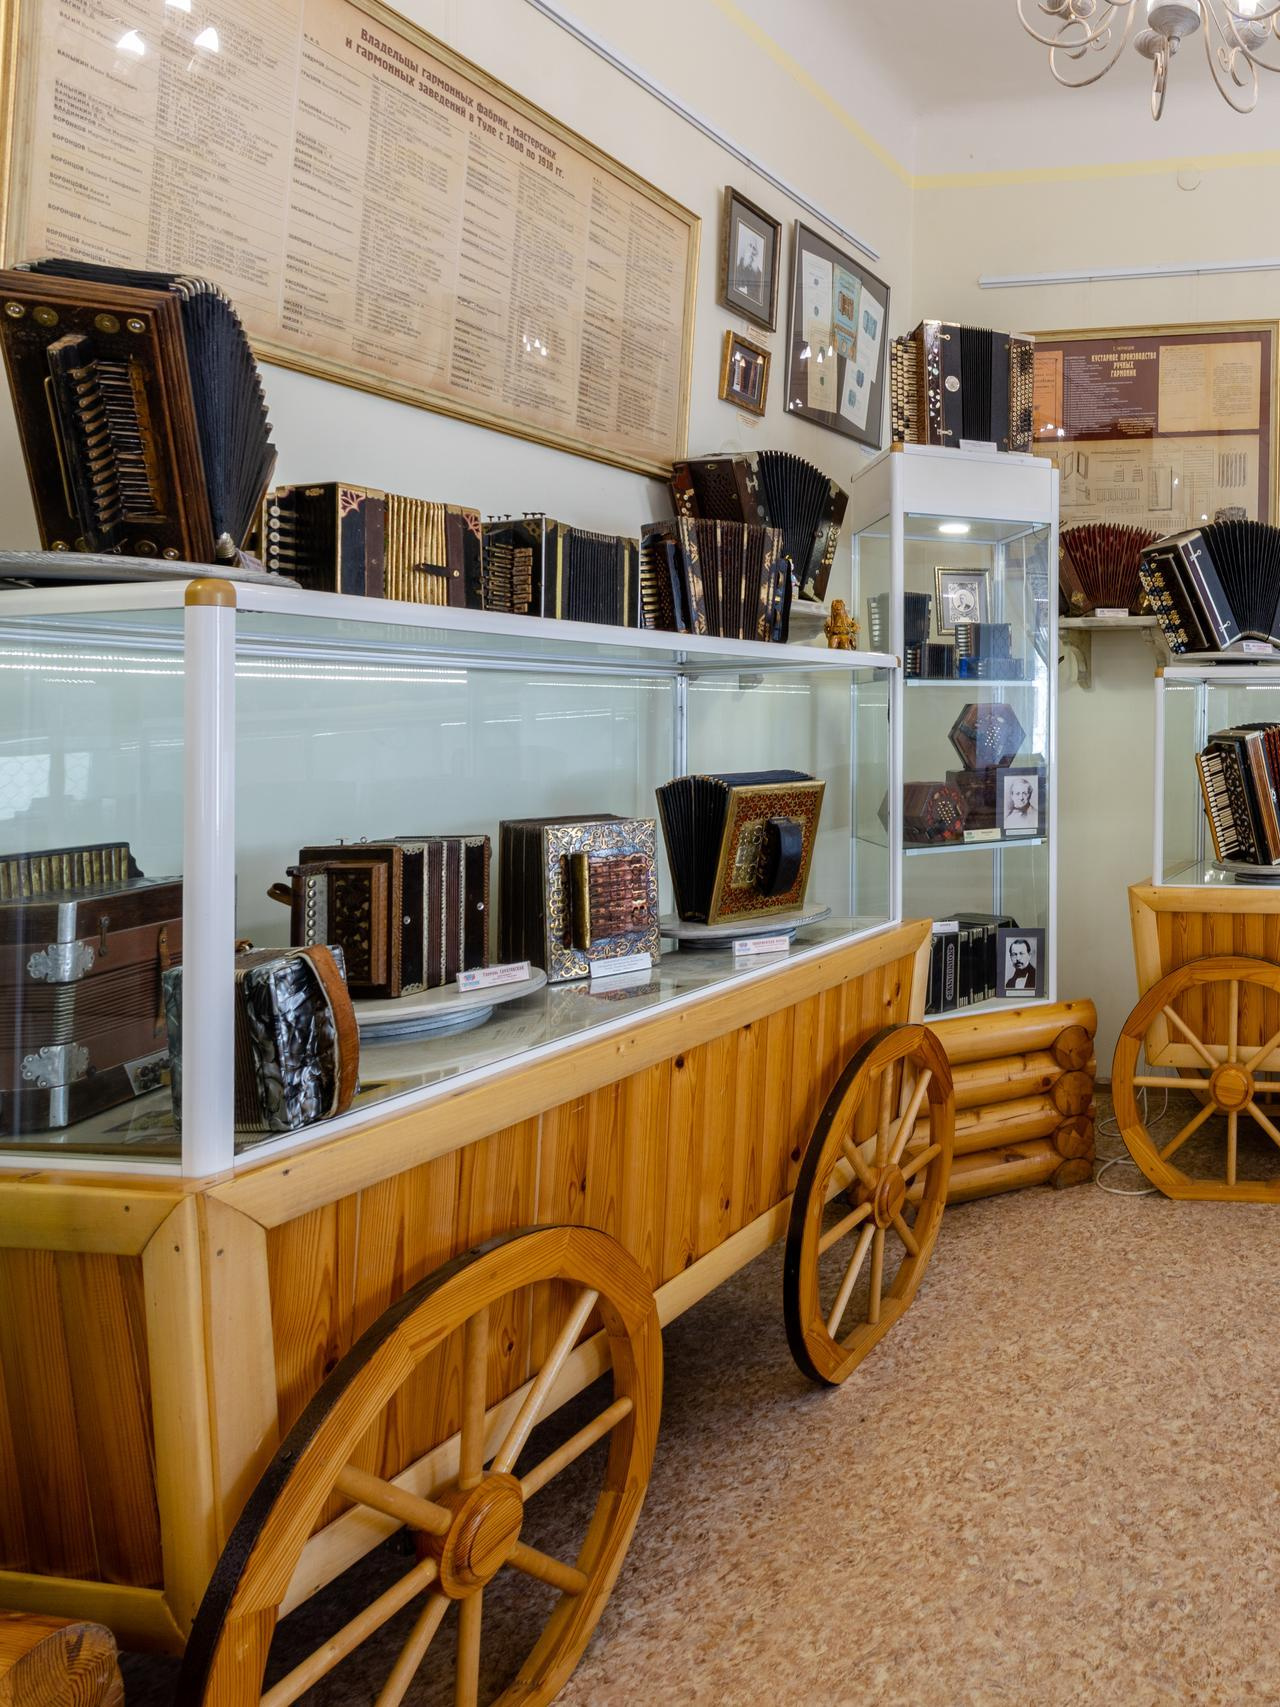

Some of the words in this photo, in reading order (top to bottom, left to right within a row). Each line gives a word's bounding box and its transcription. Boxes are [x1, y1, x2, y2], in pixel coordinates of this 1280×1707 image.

[356, 43, 415, 87] гармонных
[418, 81, 466, 117] заведений
[469, 113, 474, 123] в
[477, 115, 496, 137] Туле
[506, 134, 524, 153] 1808
[526, 148, 535, 160] по
[538, 154, 553, 172] 1918
[361, 28, 418, 73] Владельцы
[421, 67, 473, 108] гармонных
[476, 102, 510, 131] фабрик,
[513, 125, 556, 160] мастерских
[1091, 353, 1118, 362] КУСТАРНОЕ
[1120, 352, 1156, 360] ПРОИЗВОДСТВО
